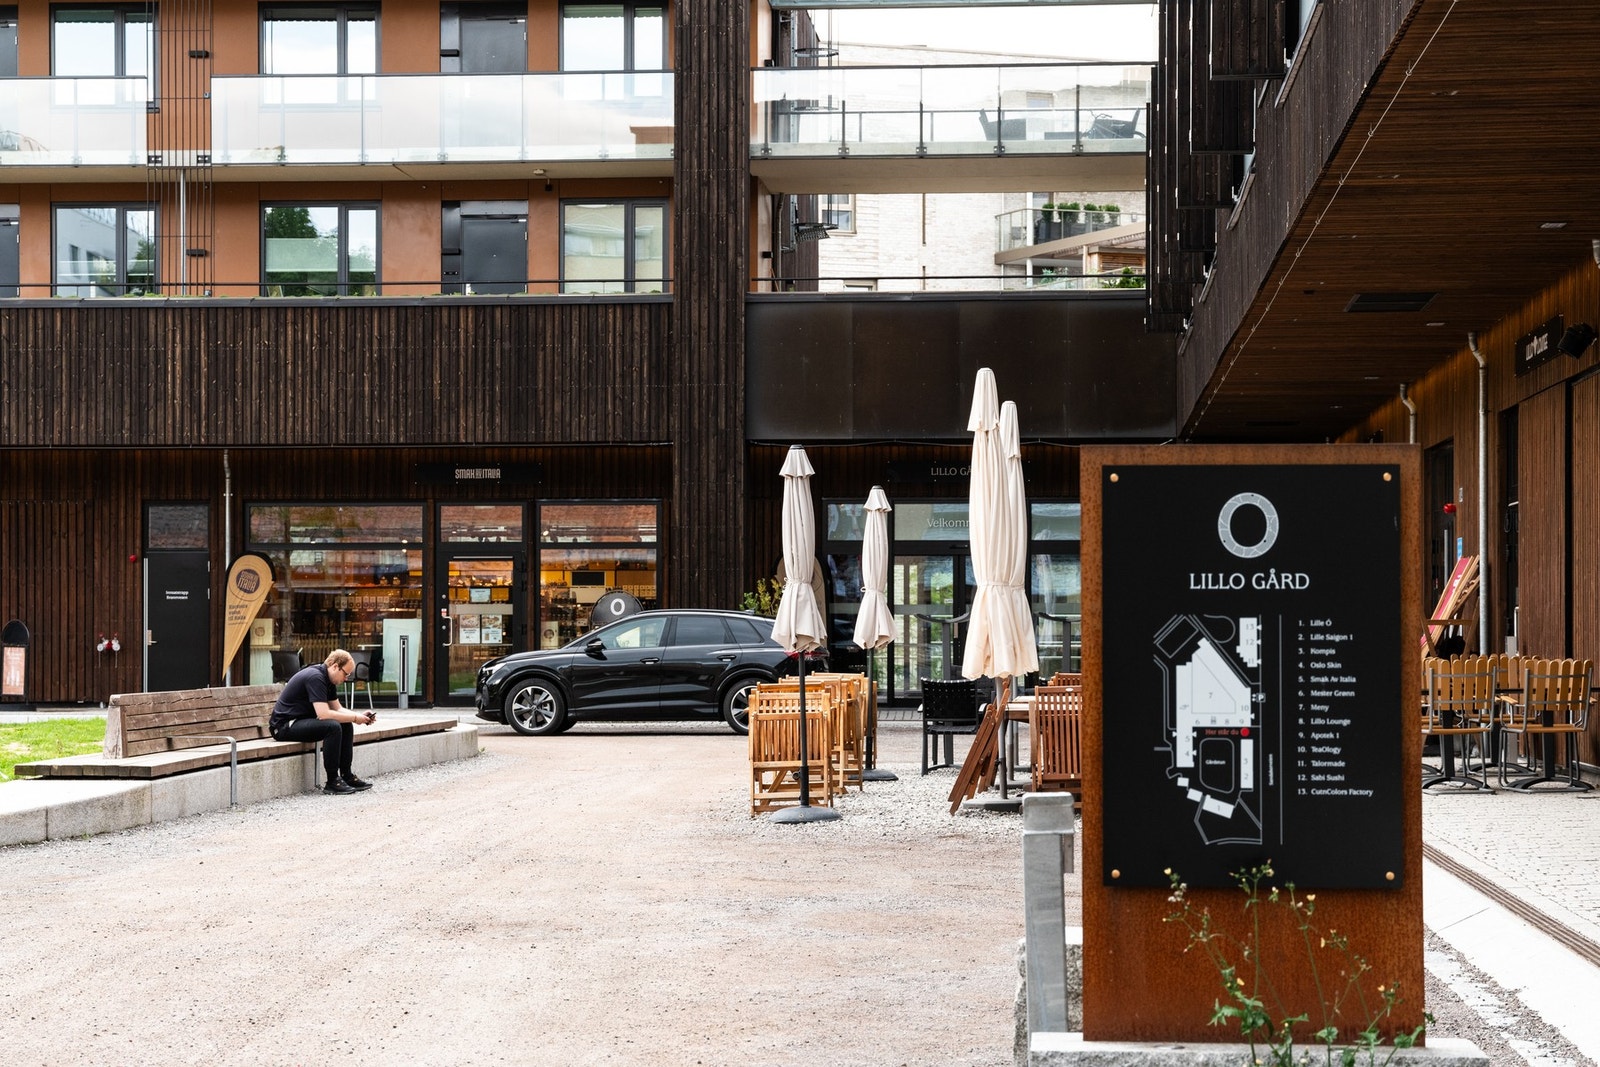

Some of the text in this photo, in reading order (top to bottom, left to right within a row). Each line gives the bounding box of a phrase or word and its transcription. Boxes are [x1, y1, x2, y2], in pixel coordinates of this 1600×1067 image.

[455, 468, 475, 479] SMAK
[1190, 568, 1309, 589] LILLO GÅRD
[1326, 634, 1348, 642] Saigon
[1311, 704, 1329, 712] Meny
[1327, 718, 1351, 726] Lounge
[1311, 732, 1334, 740] Apotek
[1349, 789, 1373, 797] Factory
